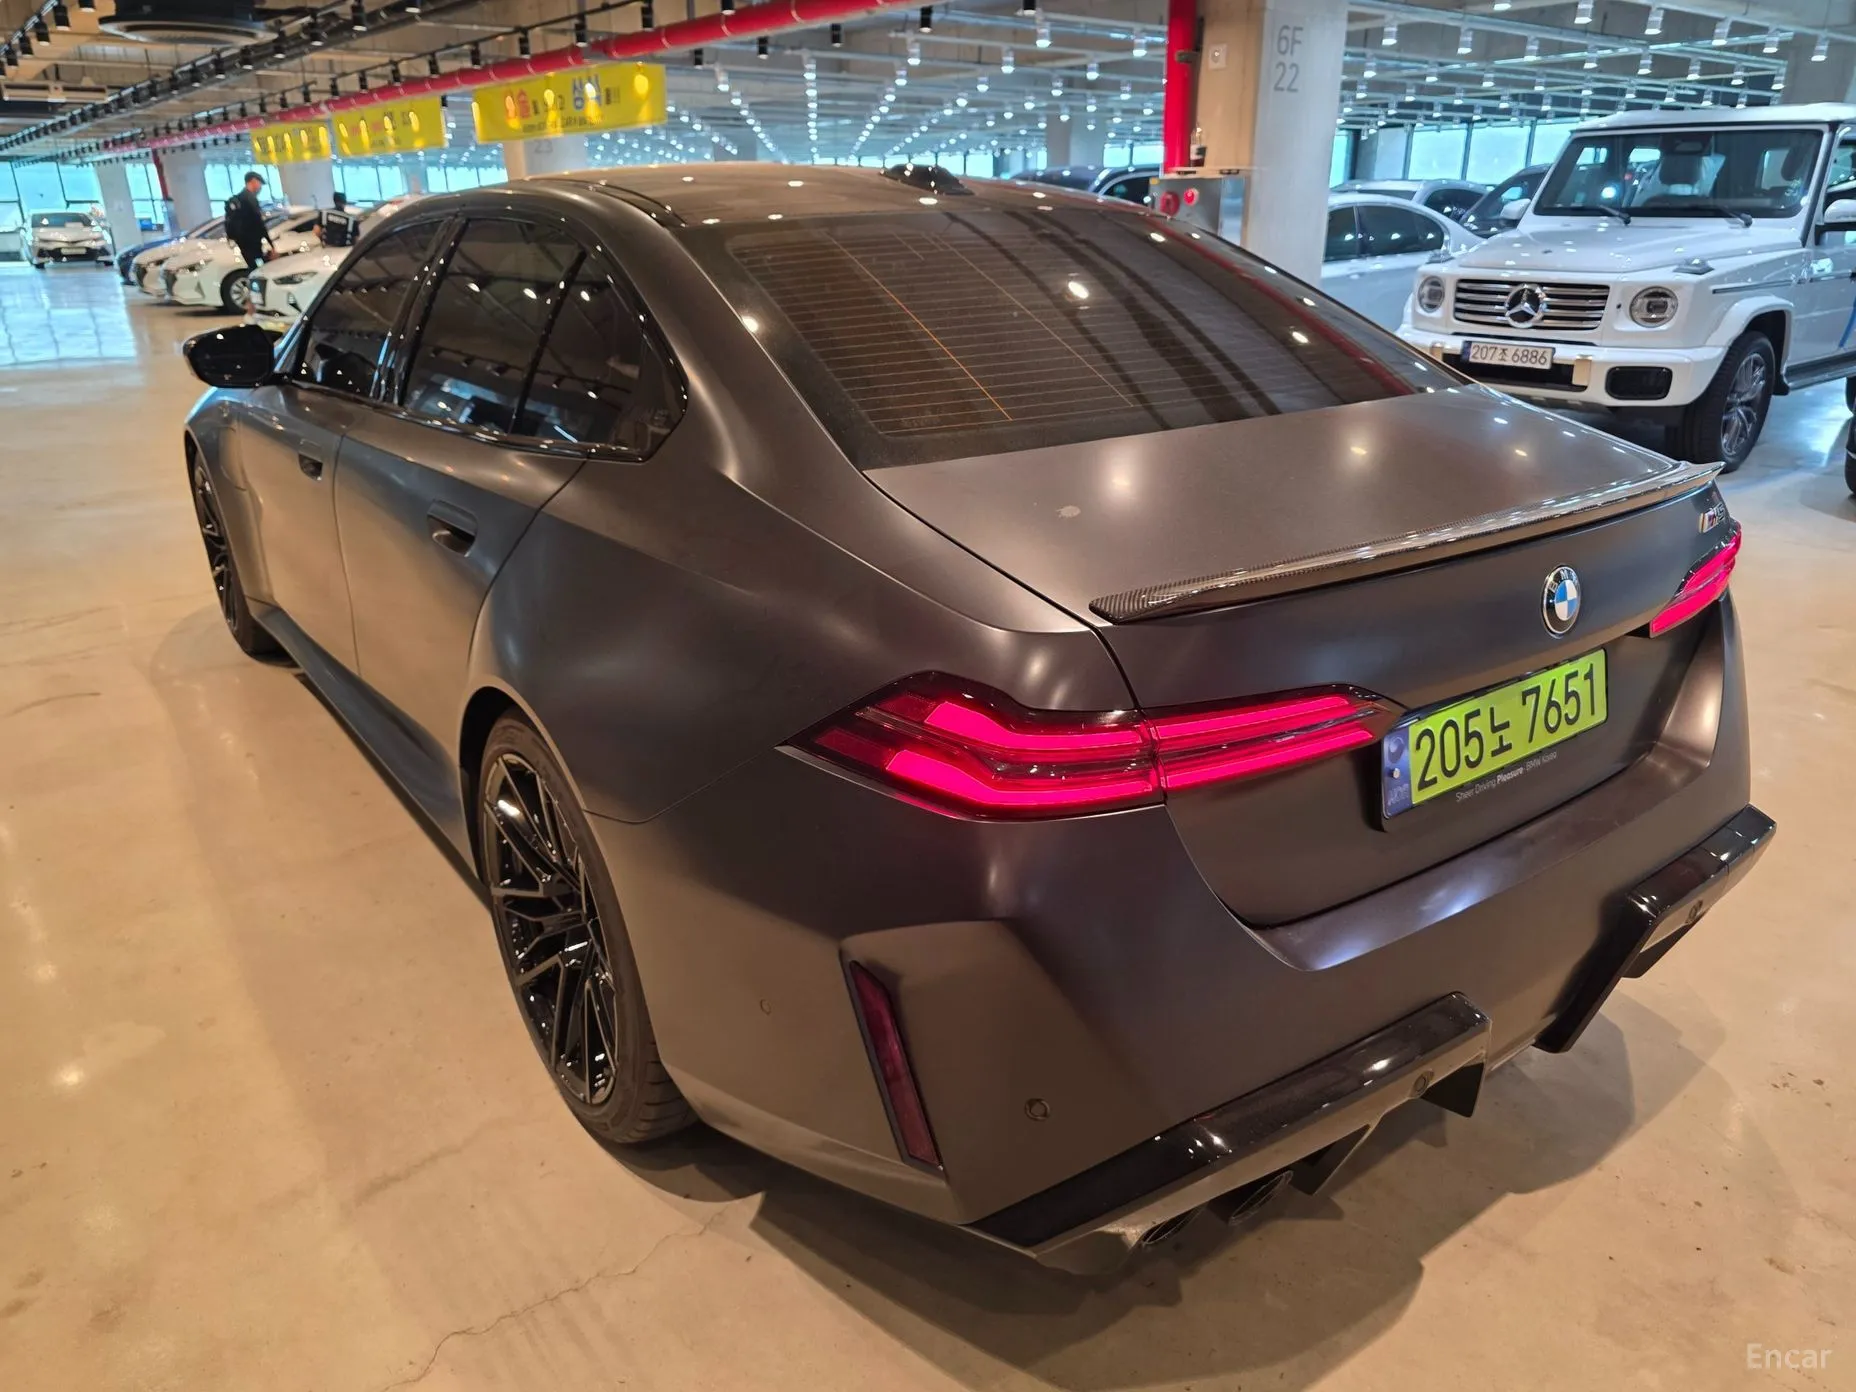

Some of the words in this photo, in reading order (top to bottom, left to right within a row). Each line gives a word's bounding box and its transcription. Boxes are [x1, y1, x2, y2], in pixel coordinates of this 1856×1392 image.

[1276, 25, 1303, 56] 6F
[1273, 62, 1299, 92] 22
[1472, 344, 1507, 361] 207조
[1511, 348, 1547, 365] 6886
[1415, 706, 1513, 792] 205노
[1521, 662, 1596, 744] 7651
